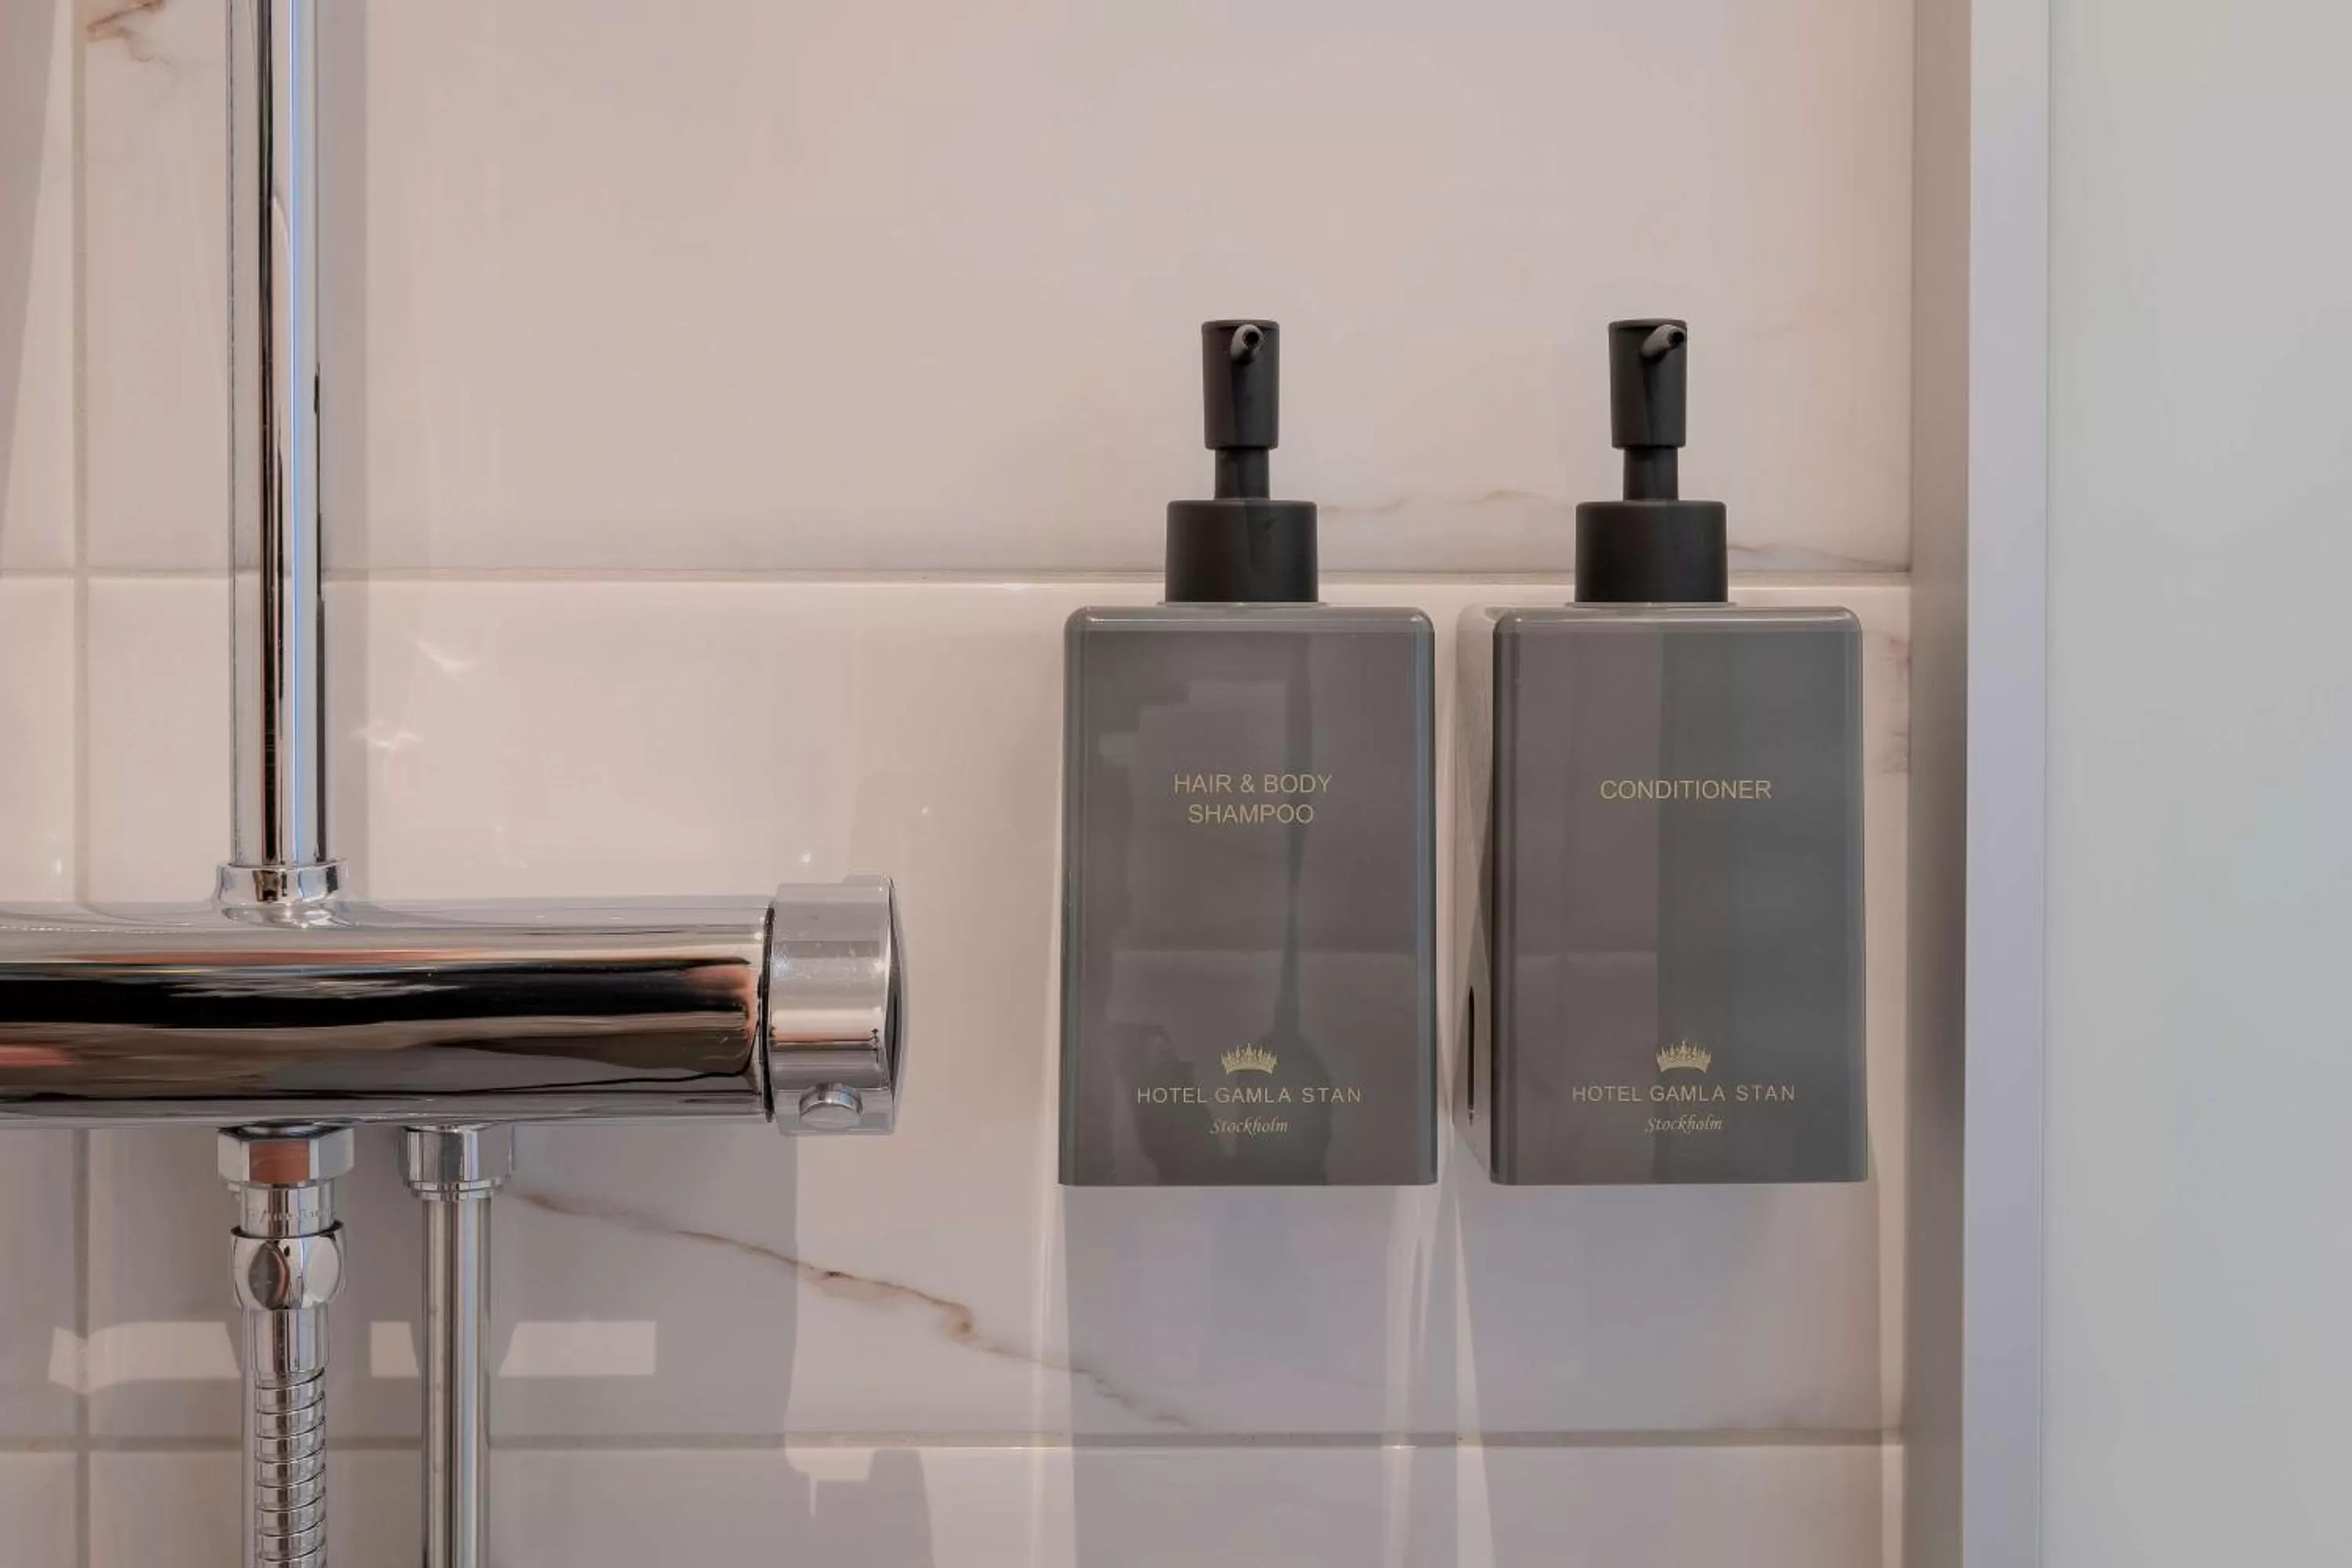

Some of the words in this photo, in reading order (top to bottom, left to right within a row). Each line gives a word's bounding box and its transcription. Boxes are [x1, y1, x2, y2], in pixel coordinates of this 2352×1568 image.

[1174, 774, 1232, 793] HAIR
[1239, 774, 1254, 793] &
[1264, 774, 1332, 793] BODY
[1600, 779, 1772, 800] CONDITIONER
[1188, 804, 1314, 824] SHAMPOO
[1138, 1087, 1207, 1104] HOTEL
[1214, 1087, 1291, 1104] GAMLA
[1302, 1087, 1361, 1104] STAN
[1573, 1085, 1642, 1102] HOTEL
[1650, 1084, 1726, 1102] GAMLA
[1736, 1084, 1795, 1102] STAN
[1209, 1116, 1289, 1136] Stockholm
[1644, 1114, 1722, 1134] Stockholm
